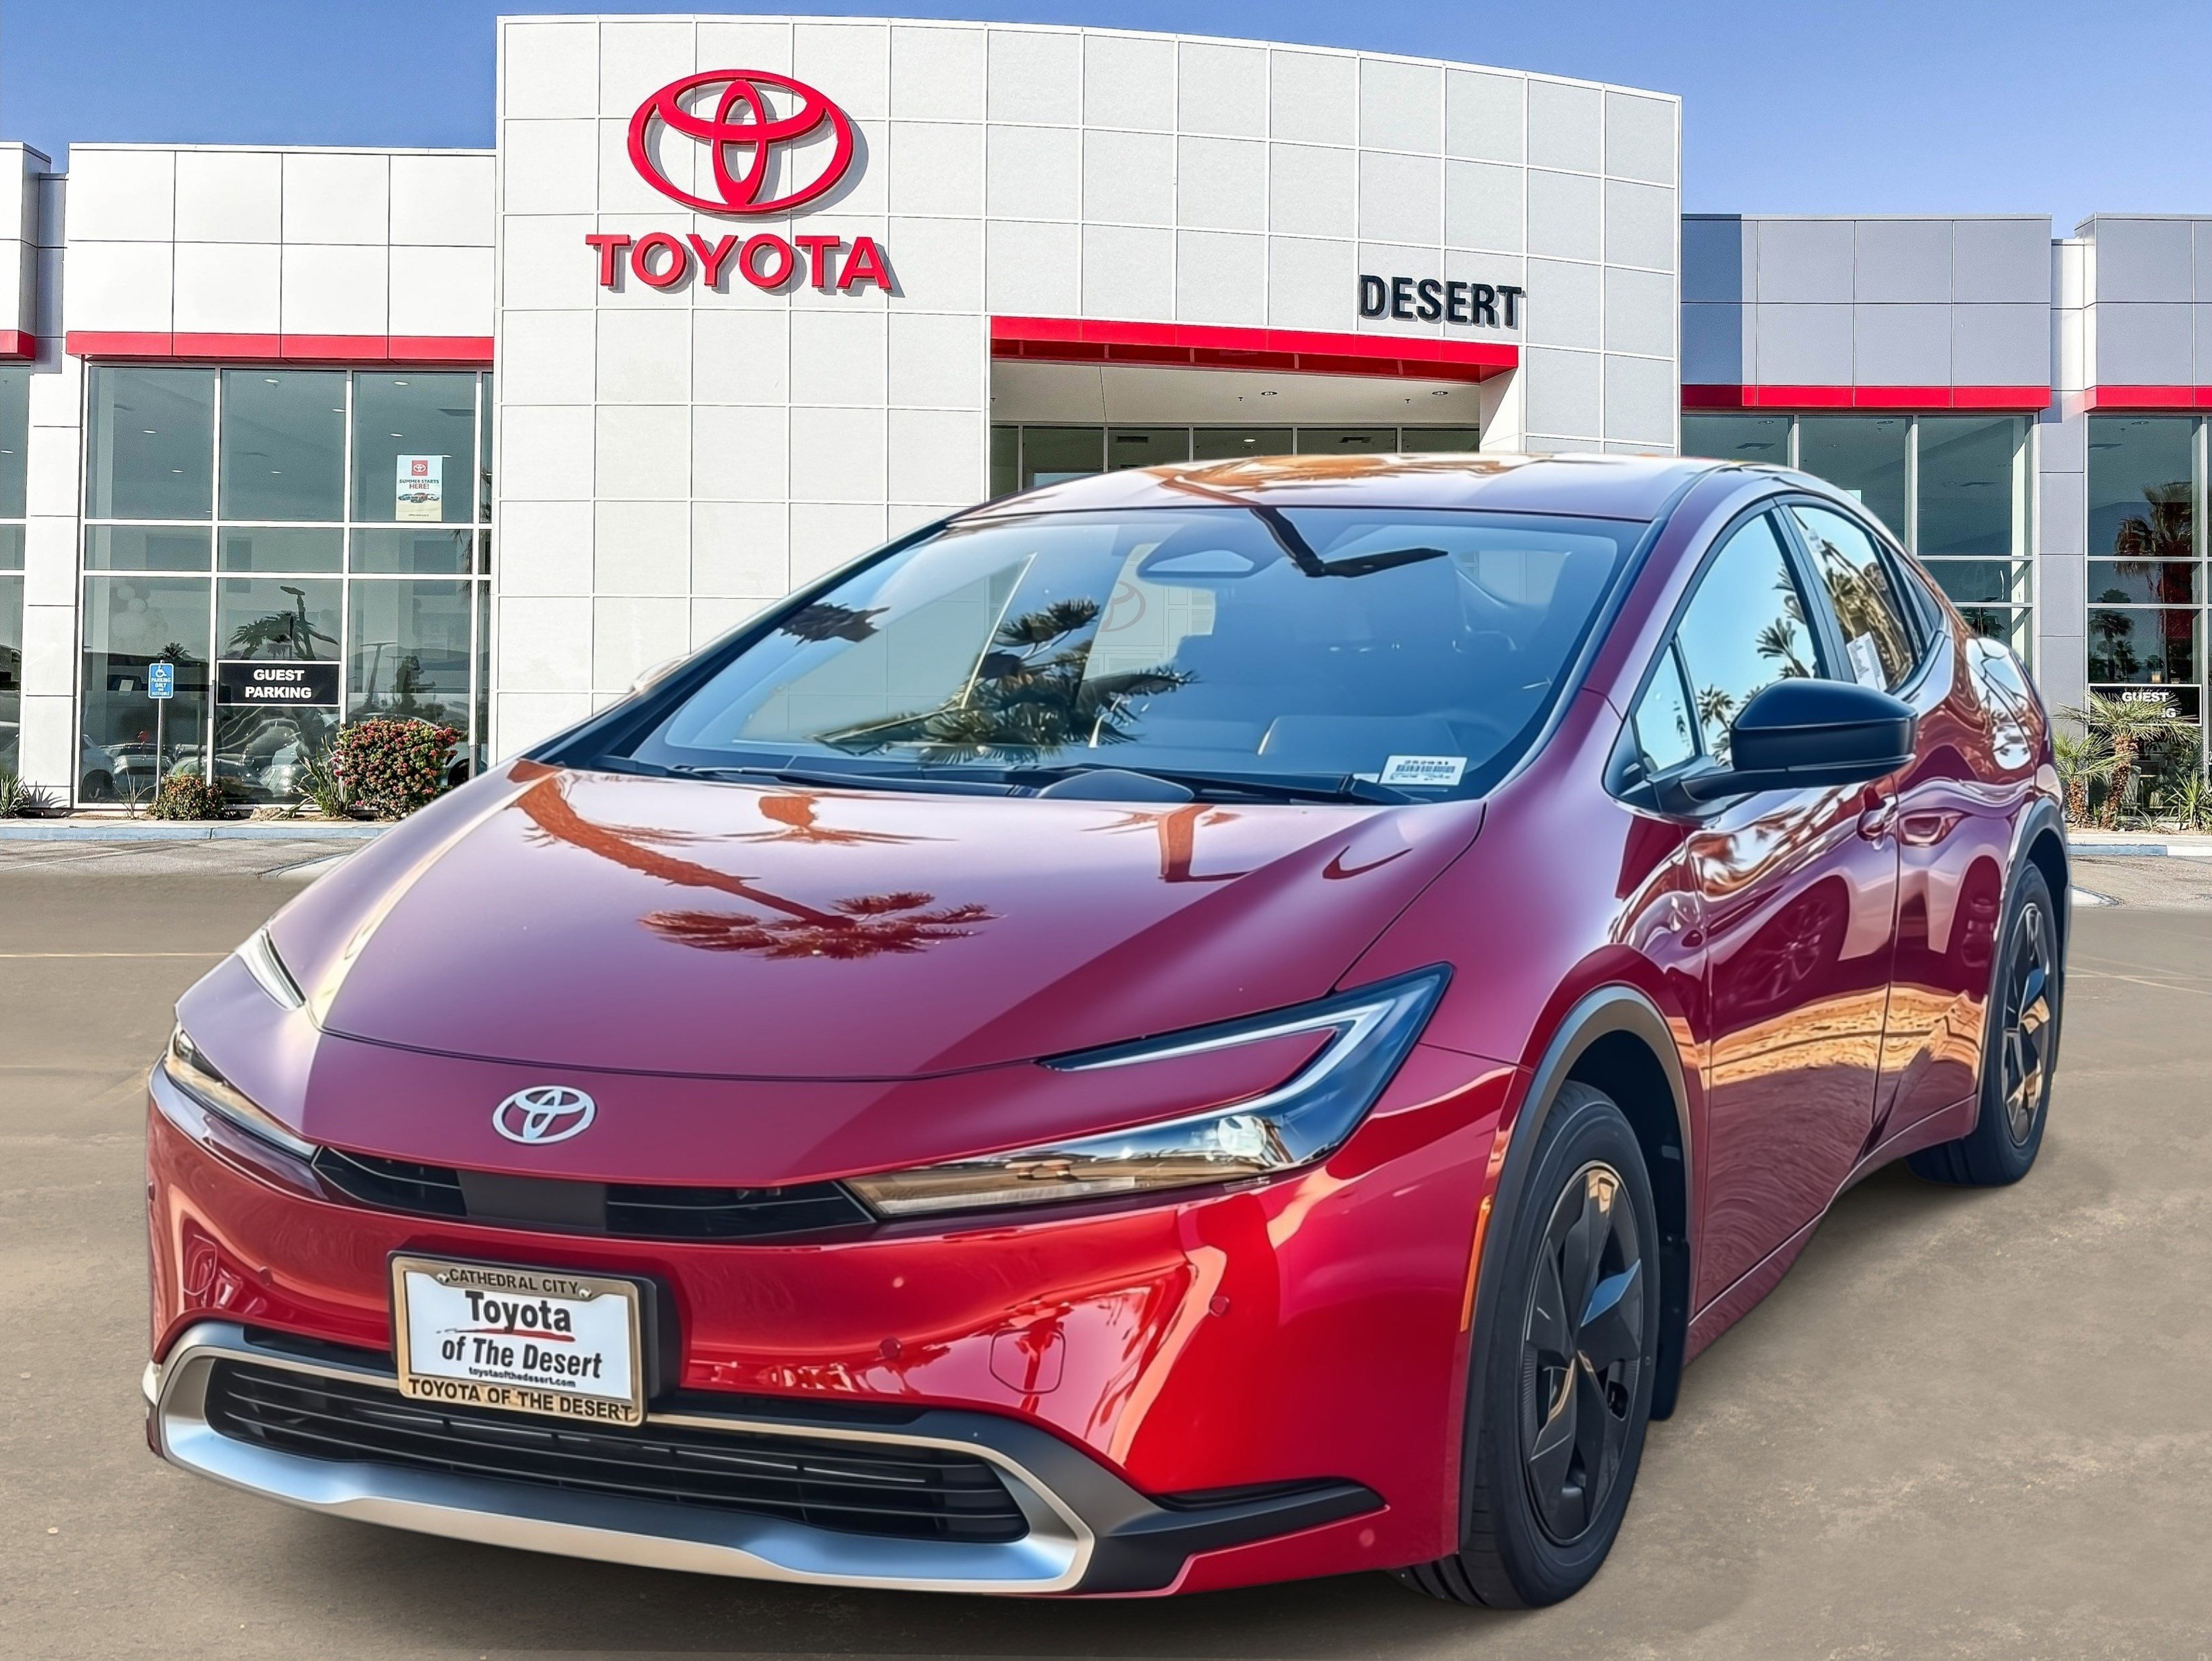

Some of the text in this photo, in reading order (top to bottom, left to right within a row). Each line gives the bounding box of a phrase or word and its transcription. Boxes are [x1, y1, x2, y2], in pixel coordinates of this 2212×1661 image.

[586, 232, 893, 291] TOYOTA
[1359, 274, 1522, 327] DESERT
[245, 686, 311, 699] PARKING
[254, 669, 305, 681] GUEST
[2121, 692, 2169, 703] GUEST
[449, 1268, 578, 1295] CATHEDRAL CITY
[465, 1290, 572, 1333] Toyota
[442, 1336, 603, 1379] of The Desert
[468, 1366, 576, 1389] toyotaofthedesert.com
[408, 1378, 633, 1421] TOYOTA OF THE DESERT
